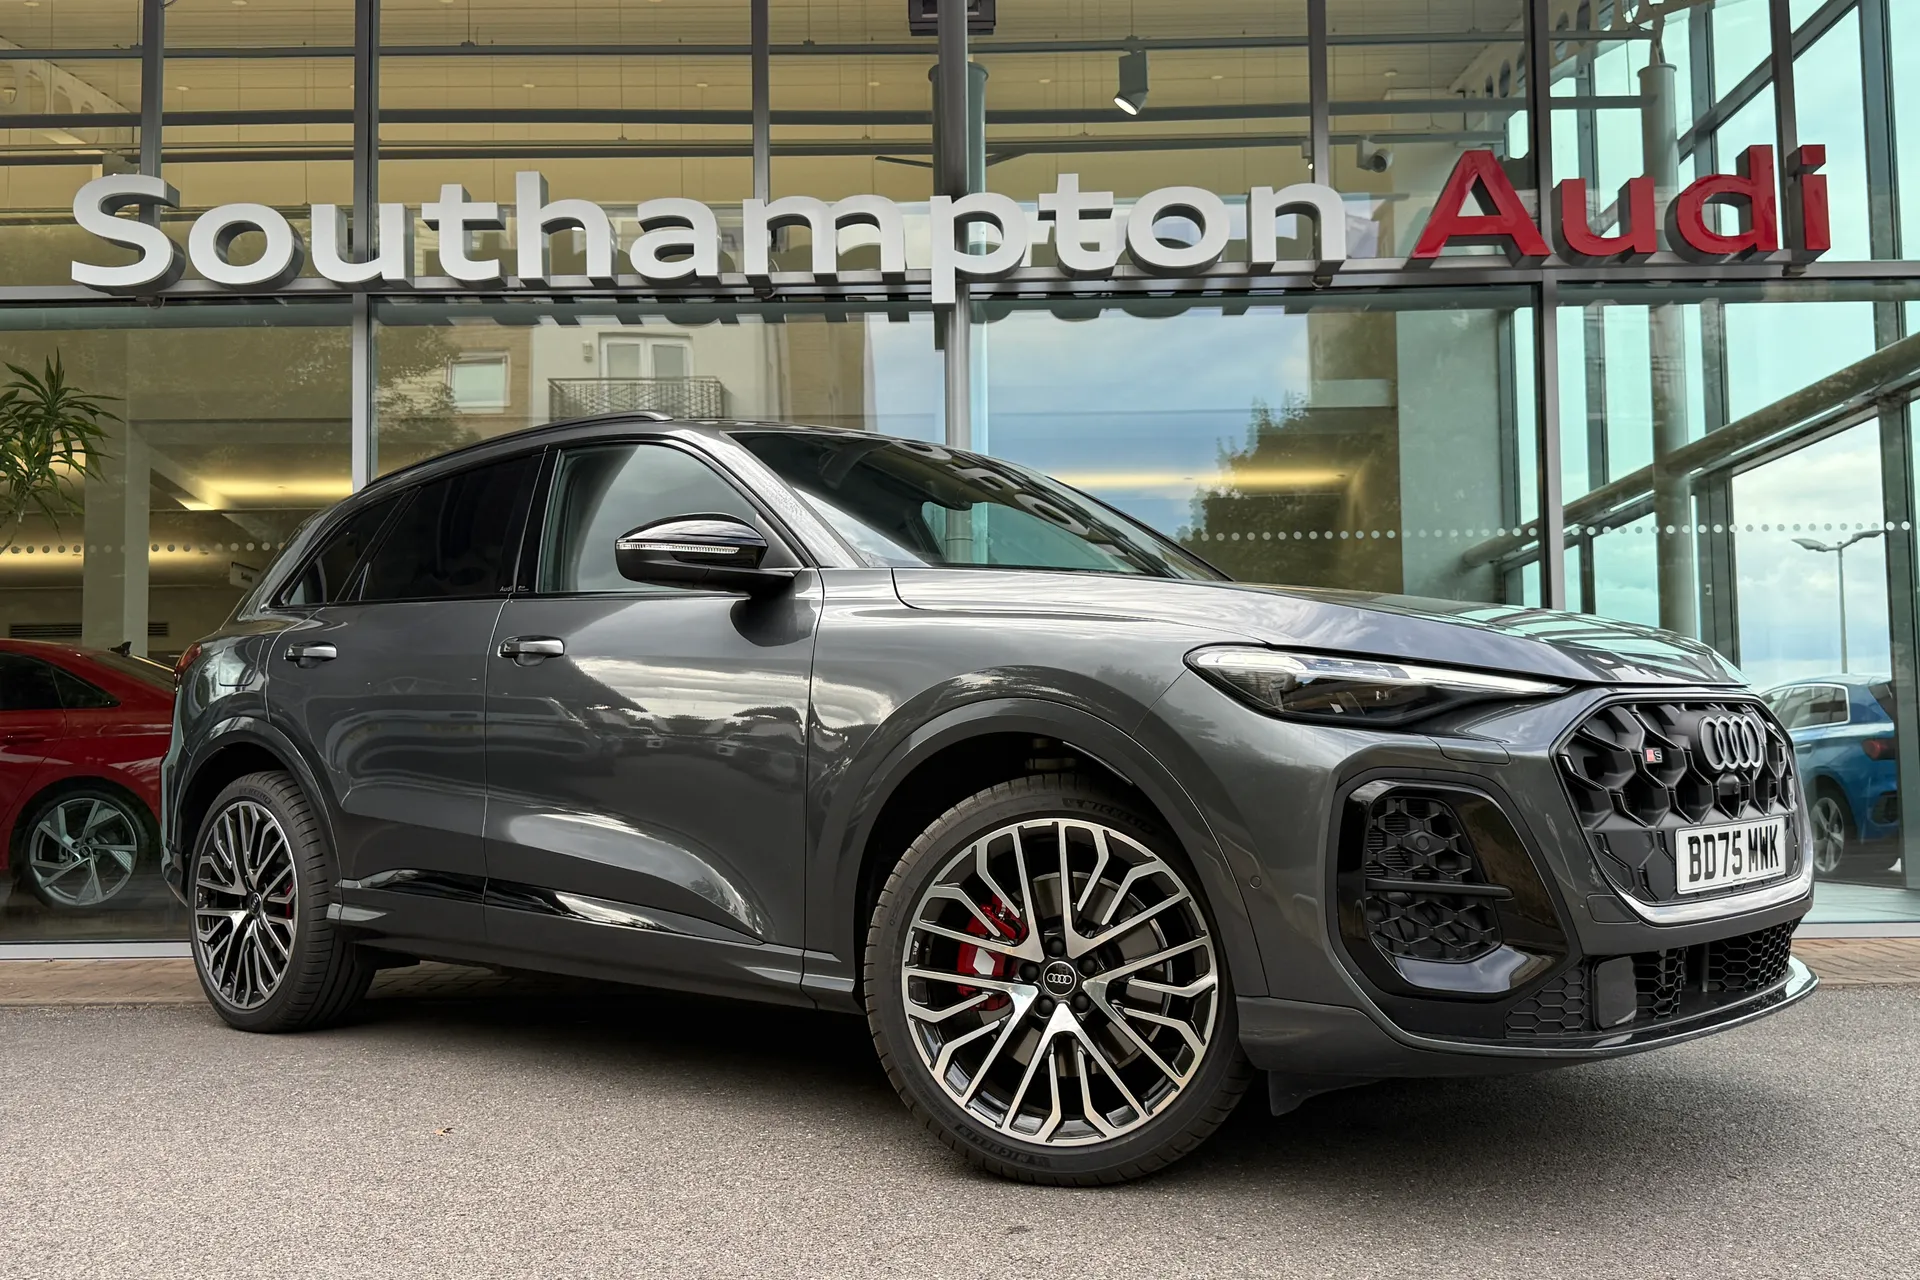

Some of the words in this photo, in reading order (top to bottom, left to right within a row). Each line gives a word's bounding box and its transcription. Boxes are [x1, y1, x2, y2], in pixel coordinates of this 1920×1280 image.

[71, 171, 1346, 304] Southampton
[1411, 145, 1831, 259] Audi
[1688, 831, 1742, 882] BD75
[1748, 824, 1779, 873] MWK
